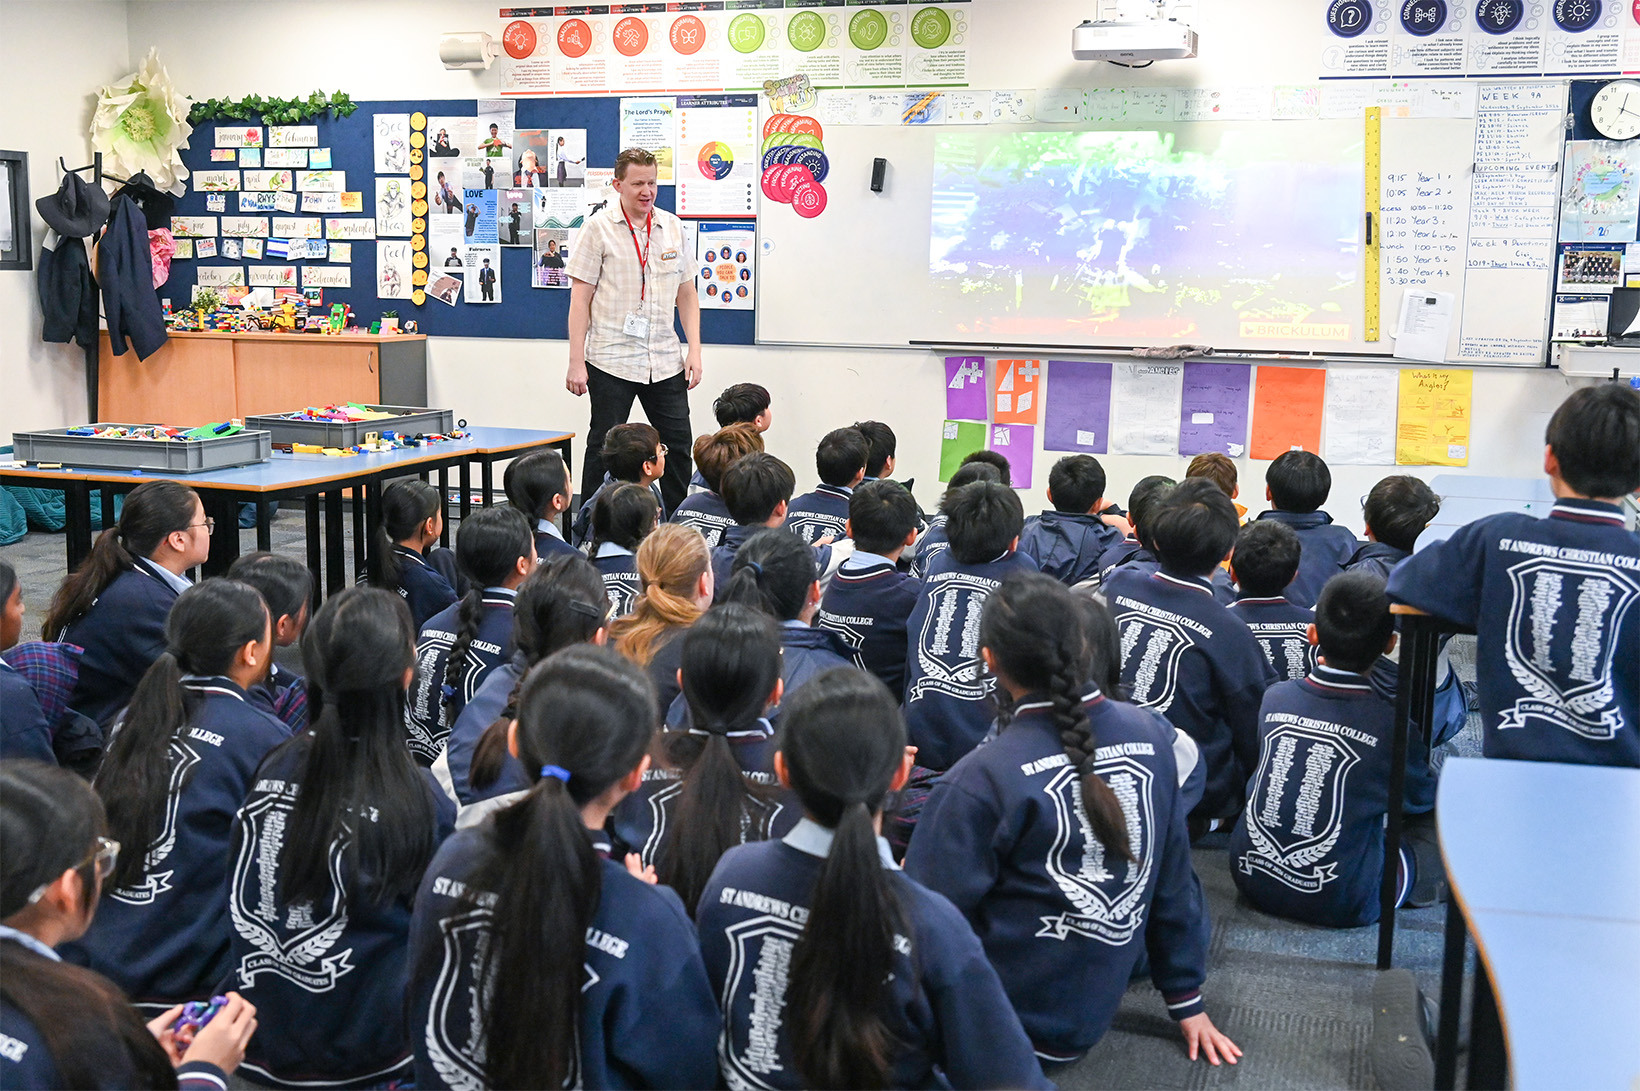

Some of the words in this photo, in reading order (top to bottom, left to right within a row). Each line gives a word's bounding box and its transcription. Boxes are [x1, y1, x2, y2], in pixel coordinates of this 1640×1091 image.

[790, 13, 816, 42] COLLABORATING
[851, 11, 871, 33] LISTENING
[914, 10, 938, 34] EMPATHISING
[505, 23, 521, 42] CREATING
[560, 21, 578, 42] ANALYSING
[615, 19, 632, 39] APPLYING
[672, 17, 696, 44] TRANSFORMING
[1481, 92, 1519, 101] WEEK
[1530, 91, 1542, 99] 9A
[653, 109, 672, 117] Prayer
[377, 118, 403, 137] See
[1387, 173, 1408, 183] 9:15
[1417, 171, 1434, 183] Year
[1437, 172, 1441, 180] 1
[257, 193, 275, 203] RHYS
[465, 190, 483, 198] LOVE
[506, 191, 524, 199] love
[1386, 188, 1408, 198] 10:05
[1416, 186, 1434, 197] Year
[1434, 187, 1442, 196] 2
[304, 196, 322, 204] JOHN
[379, 219, 405, 233] Hear
[1386, 216, 1407, 225] 11:20
[1411, 215, 1431, 225] Year
[1432, 215, 1439, 225] 3
[1386, 230, 1407, 238] 12:10
[1412, 229, 1430, 239] Year
[1431, 229, 1438, 238] 6
[1470, 239, 1497, 247] Week
[1511, 239, 1548, 247] Devotions
[1386, 255, 1409, 264] 1:50
[1413, 255, 1432, 264] Year
[1434, 255, 1441, 263] 5
[1386, 267, 1409, 275] 2:40
[1413, 266, 1434, 276] Year
[1436, 269, 1443, 277] 4
[1387, 277, 1409, 285] 3:30
[1256, 324, 1346, 338] BRICKULUM
[1412, 371, 1432, 380] What
[1418, 379, 1449, 392] Angles?
[683, 510, 703, 519] ANDREWS
[702, 513, 728, 524] CHRISTIAN
[795, 510, 816, 519] ANDREWS
[814, 513, 840, 523] CHRISTIAN
[1499, 538, 1512, 551] ST
[1510, 540, 1560, 559] ANDREWS
[1558, 547, 1616, 567] CHRISTIAN
[933, 571, 958, 582] ANDREWS
[957, 573, 992, 587] CHRISTIAN
[846, 615, 874, 625] COLLEGE
[1122, 597, 1149, 614] ANDREWS
[1147, 606, 1182, 624] CHRISTIAN
[1180, 616, 1213, 639] COLLEGE
[1260, 622, 1296, 631] CHRISTIAN
[470, 639, 502, 655] COLLEGE
[951, 687, 984, 696] GRADUATES
[1520, 704, 1544, 713] CLASS
[1272, 713, 1300, 726] ANDREWS
[1297, 716, 1342, 734] CHRISTIAN
[1340, 726, 1379, 748] COLLEGE
[1122, 742, 1157, 756] COLLEGE
[1020, 762, 1035, 776] ST
[1249, 856, 1266, 868] CLASS
[1264, 860, 1273, 870] OF
[1282, 872, 1319, 888] GRADUATES
[720, 887, 738, 905] ST
[733, 889, 791, 920] ANDREWS
